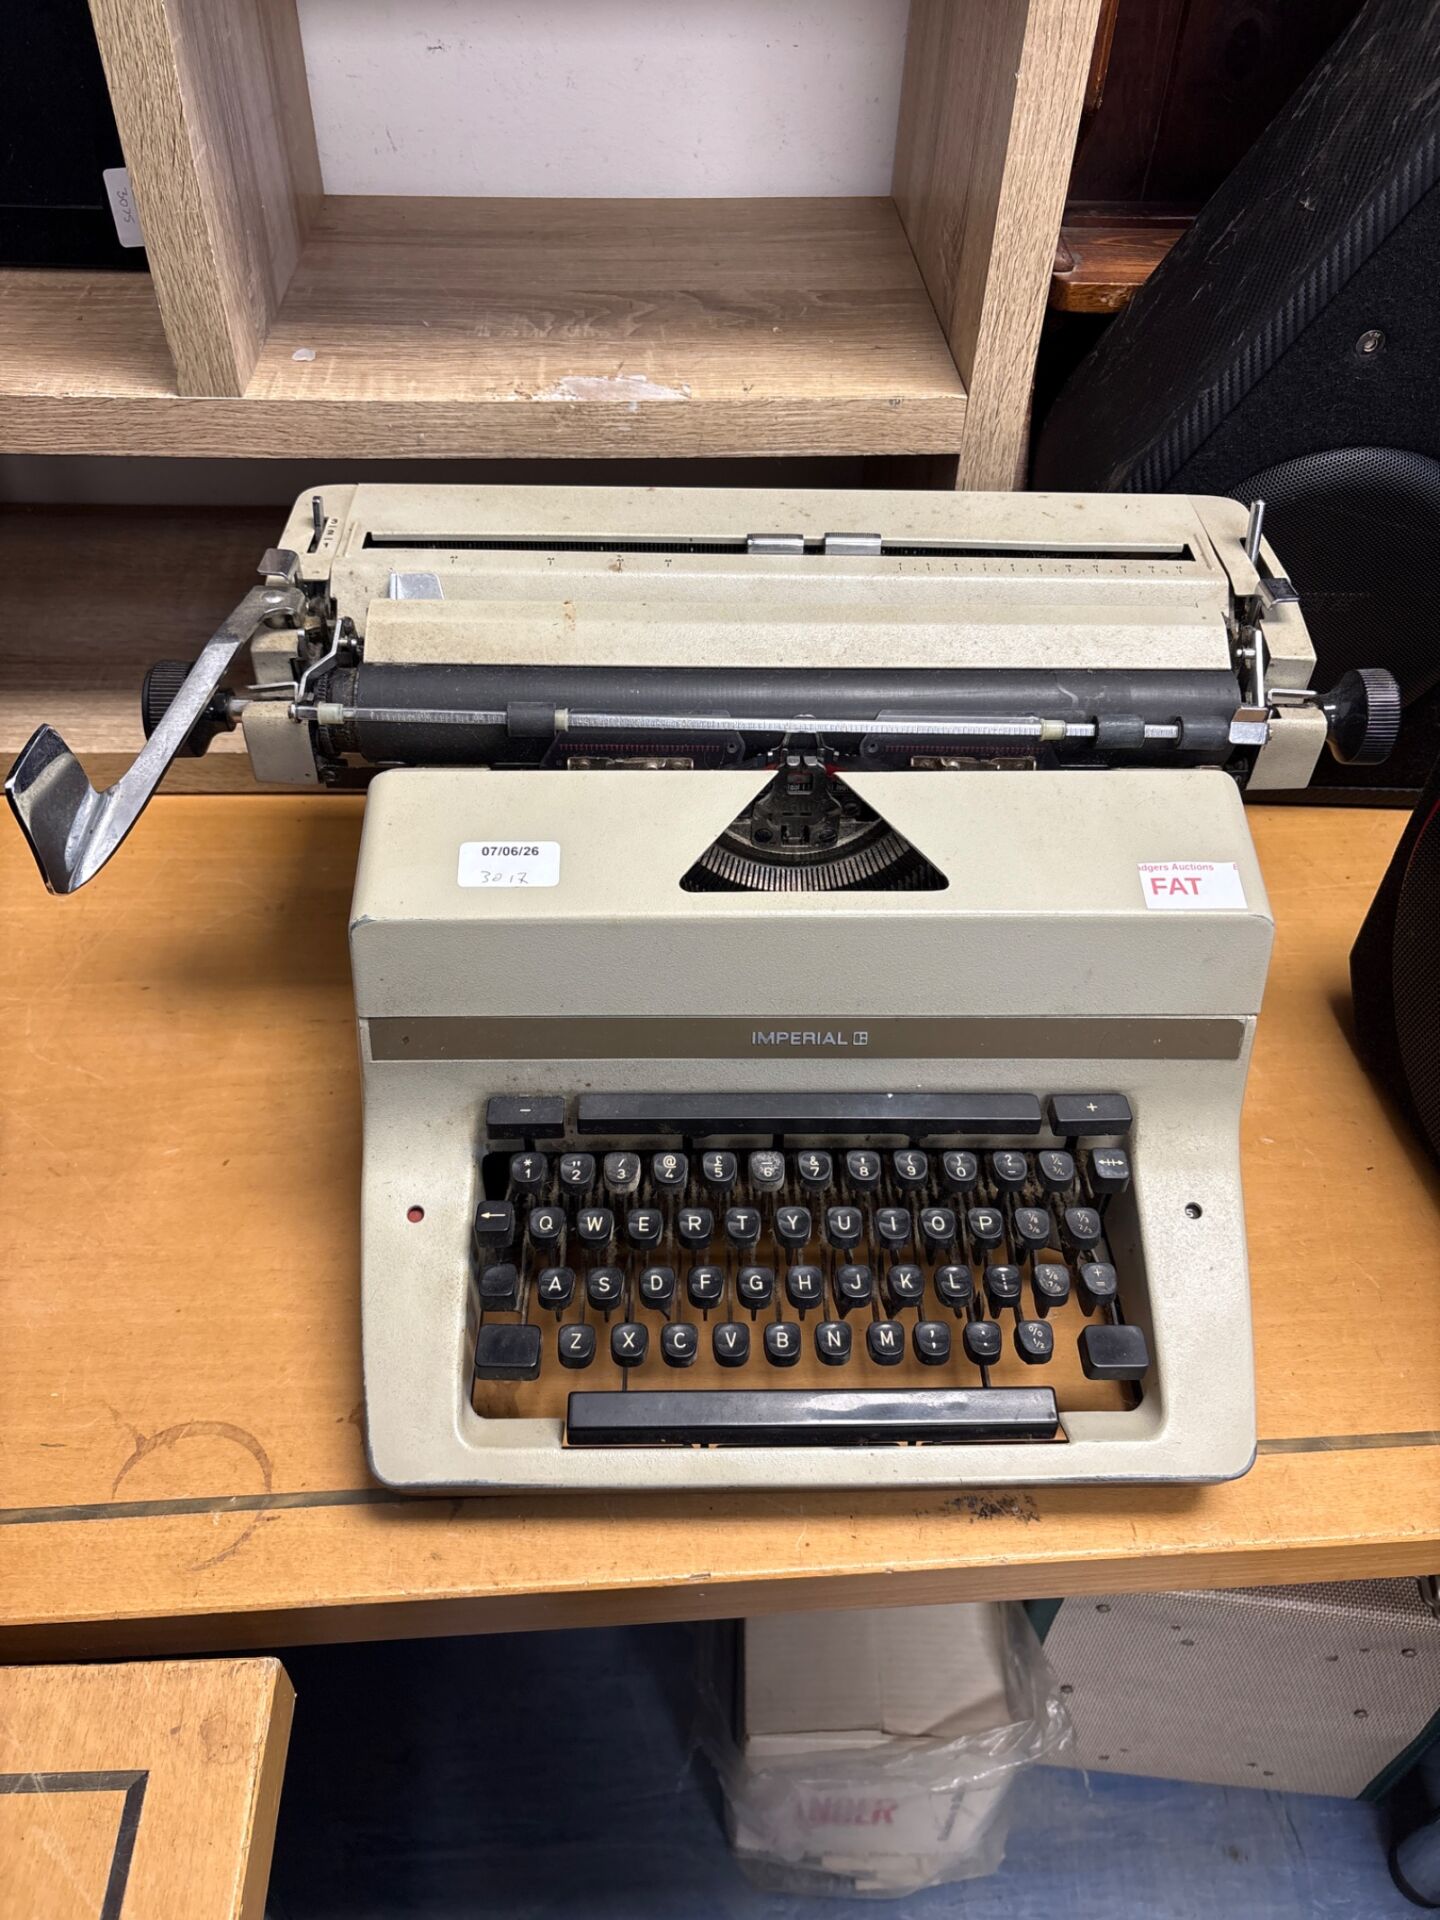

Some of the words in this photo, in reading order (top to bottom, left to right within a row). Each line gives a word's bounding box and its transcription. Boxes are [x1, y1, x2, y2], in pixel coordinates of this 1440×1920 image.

[481, 846, 540, 856] 07/06/26
[1172, 863, 1214, 871] Auctions
[1150, 877, 1202, 895] FAT
[752, 1031, 849, 1045] IMPERIAL
[525, 1169, 531, 1178] 1
[572, 1170, 581, 1180] 2
[617, 1170, 626, 1179] 3
[665, 1168, 674, 1178] 4
[714, 1168, 723, 1177] 5
[763, 1168, 773, 1177] 6
[810, 1167, 819, 1176] 7
[859, 1167, 869, 1177] 8
[907, 1166, 916, 1176] 9
[956, 1167, 966, 1177] 0
[539, 1216, 553, 1230] Q
[587, 1216, 603, 1231] W
[638, 1216, 650, 1231] E
[688, 1216, 701, 1230] R
[736, 1215, 748, 1230] T
[787, 1215, 798, 1230] Y
[838, 1215, 850, 1230] U
[890, 1216, 896, 1231] I
[931, 1216, 945, 1231] O
[979, 1216, 992, 1230] P
[548, 1275, 562, 1291] A
[598, 1277, 610, 1292] S
[650, 1275, 663, 1291] D
[700, 1274, 711, 1290] F
[750, 1275, 763, 1290] G
[799, 1275, 812, 1290] H
[850, 1274, 861, 1290] J
[900, 1273, 913, 1289] K
[949, 1273, 961, 1289] L
[570, 1333, 581, 1349] Z
[622, 1332, 636, 1348] X
[673, 1332, 686, 1349] C
[725, 1332, 737, 1348] V
[776, 1332, 789, 1348] B
[827, 1331, 840, 1347] N
[880, 1331, 895, 1347] M
